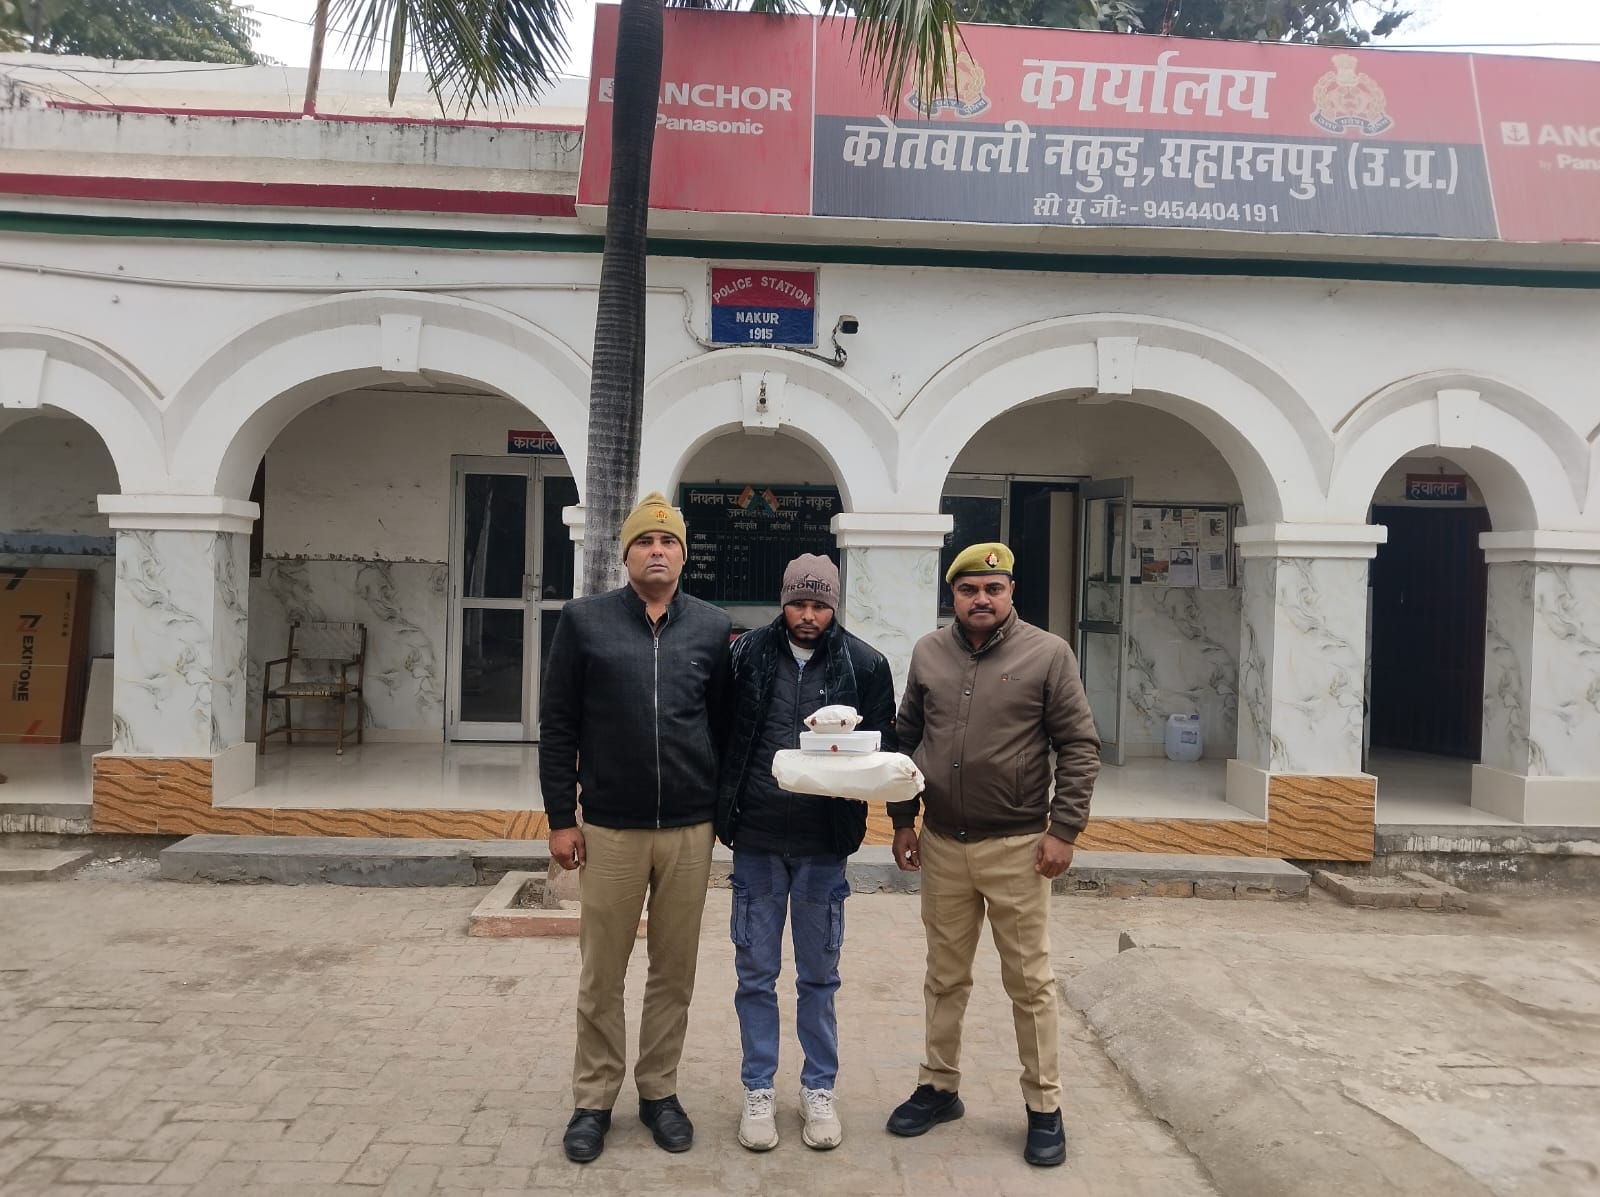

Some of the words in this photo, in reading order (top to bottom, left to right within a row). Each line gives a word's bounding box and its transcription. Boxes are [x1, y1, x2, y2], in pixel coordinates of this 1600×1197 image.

[658, 81, 792, 112] NCHOR
[1020, 50, 1277, 119] कार्यालय
[655, 113, 764, 135] Panasonic
[842, 115, 1037, 173] कोतवाली
[1033, 193, 1063, 217] सी
[1066, 199, 1086, 225] यू
[712, 276, 753, 303] POLICE
[760, 276, 812, 306] STATION
[736, 311, 780, 325] NAKUR
[749, 328, 774, 340] 1915
[512, 432, 558, 452] कार्याल
[1411, 480, 1461, 499] हवालात
